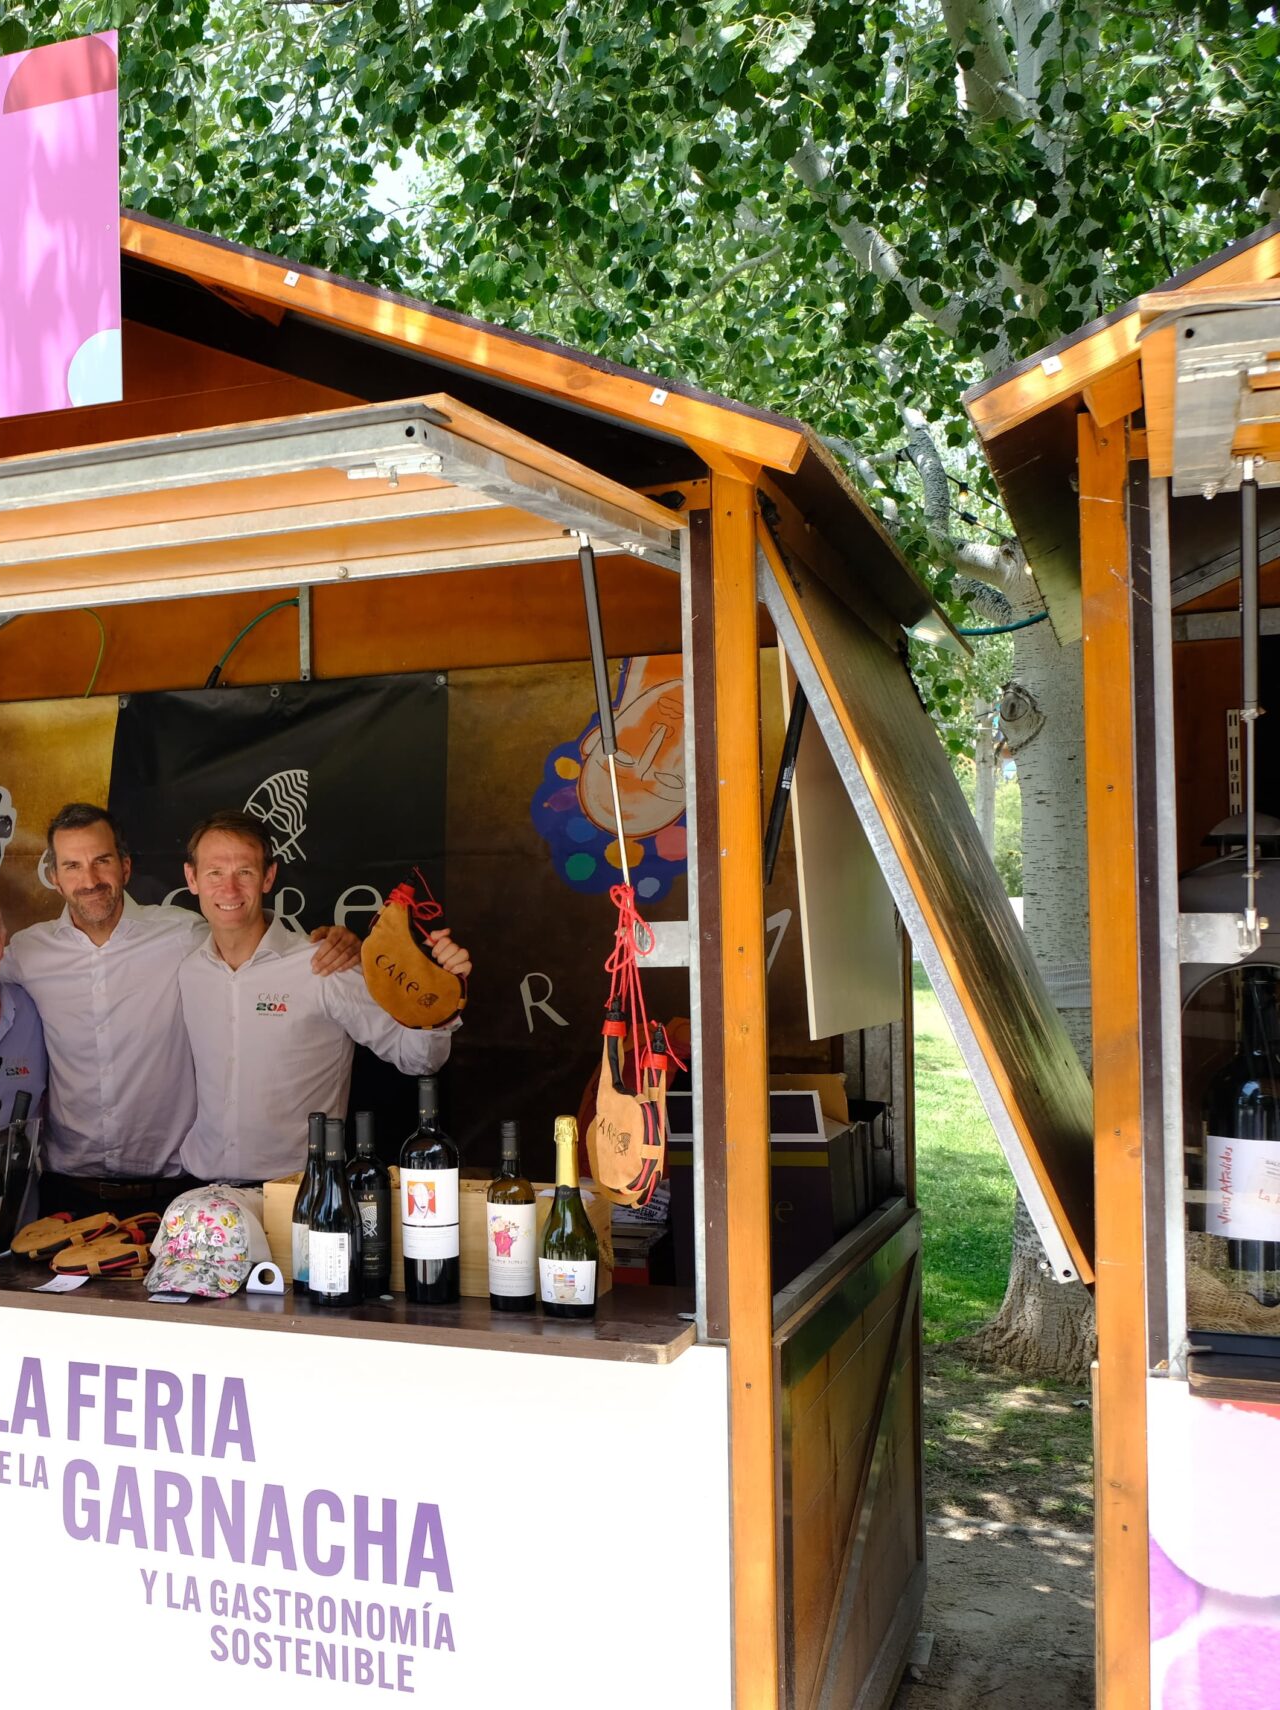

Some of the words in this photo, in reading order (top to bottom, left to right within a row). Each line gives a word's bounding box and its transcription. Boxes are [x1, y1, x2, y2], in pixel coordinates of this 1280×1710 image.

[67, 1361, 256, 1463] FERIA
[18, 1452, 49, 1490] LA
[62, 1458, 454, 1594] GARNACHA
[139, 1568, 158, 1605] Y
[166, 1572, 202, 1613] LA
[209, 1579, 456, 1653] GASTRONOMÍA
[209, 1624, 416, 1694] SOSTENIBLE
